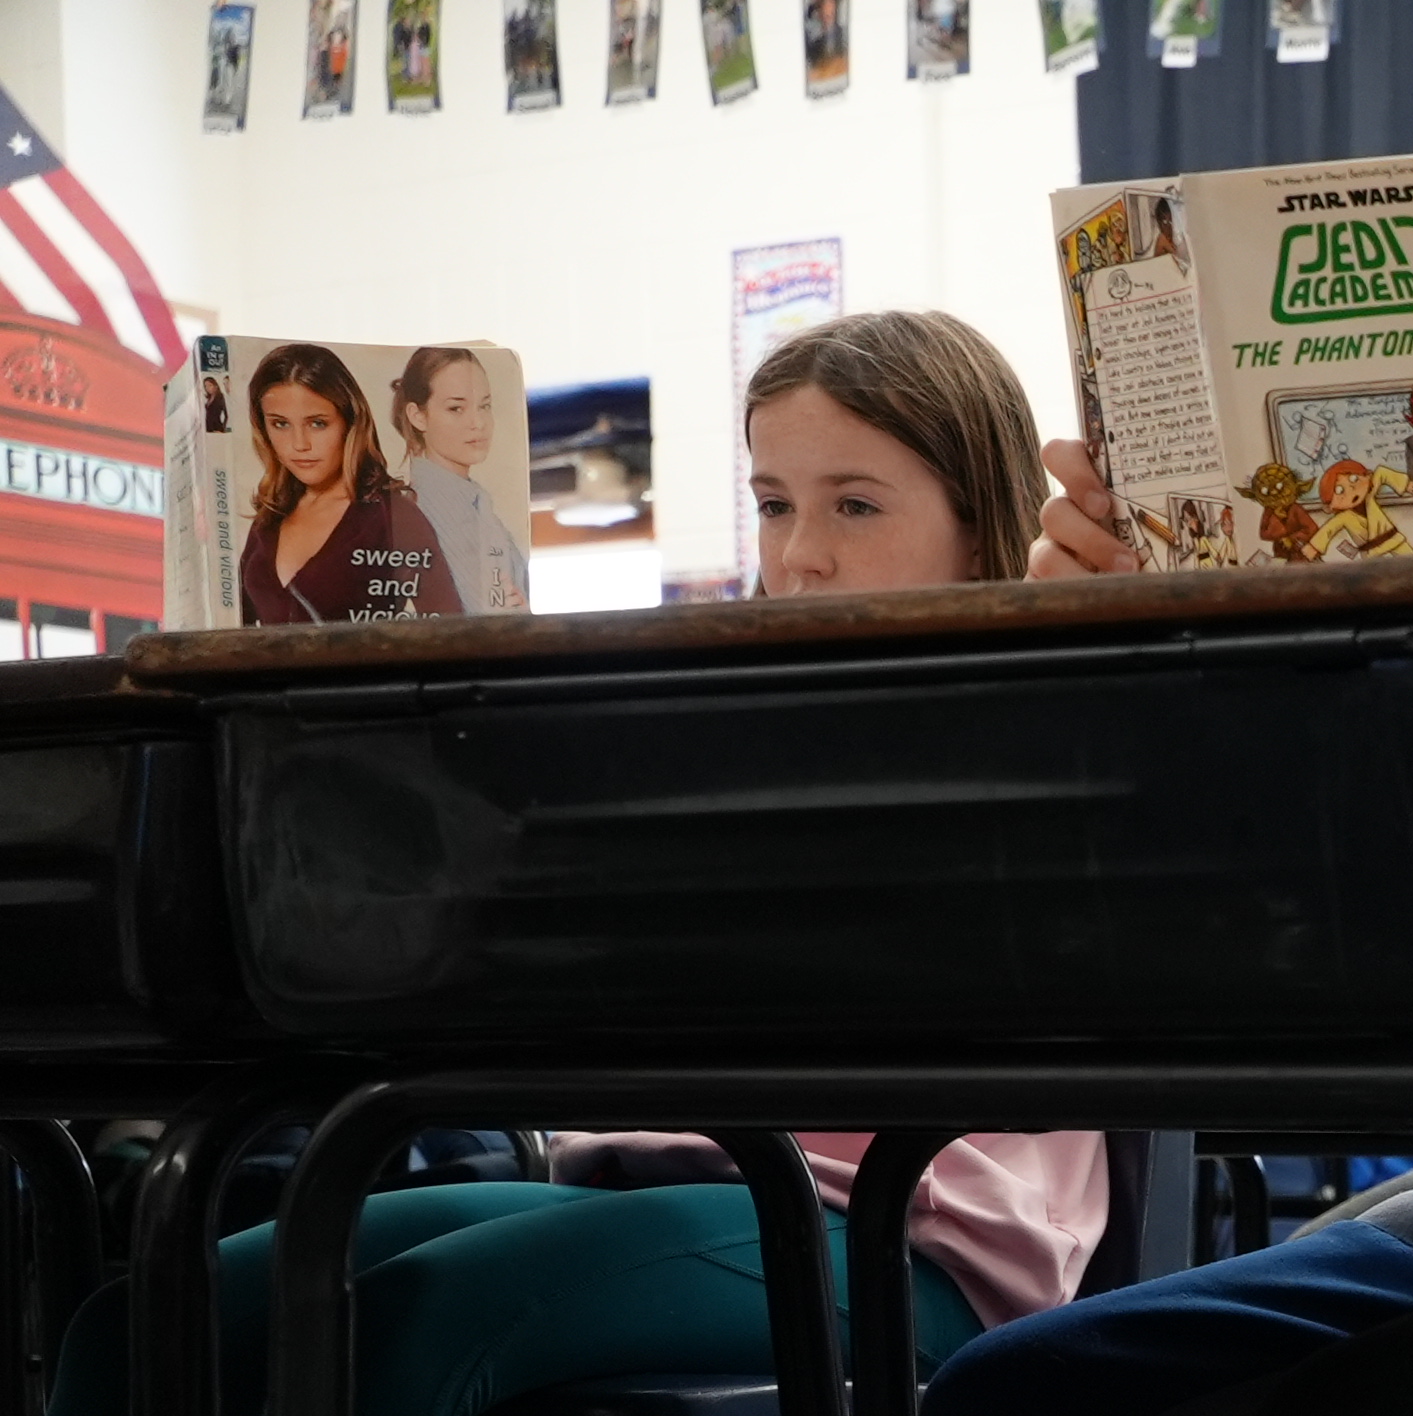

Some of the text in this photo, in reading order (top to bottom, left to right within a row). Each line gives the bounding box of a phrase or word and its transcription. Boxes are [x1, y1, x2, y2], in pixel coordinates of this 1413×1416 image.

[1277, 192, 1347, 213] STAR
[1296, 216, 1411, 275] JEDI
[1232, 340, 1284, 369] THE
[7, 447, 166, 513] EPHON
[215, 468, 234, 608] sweet and vicious
[351, 547, 433, 569] sweet
[367, 573, 420, 597] and
